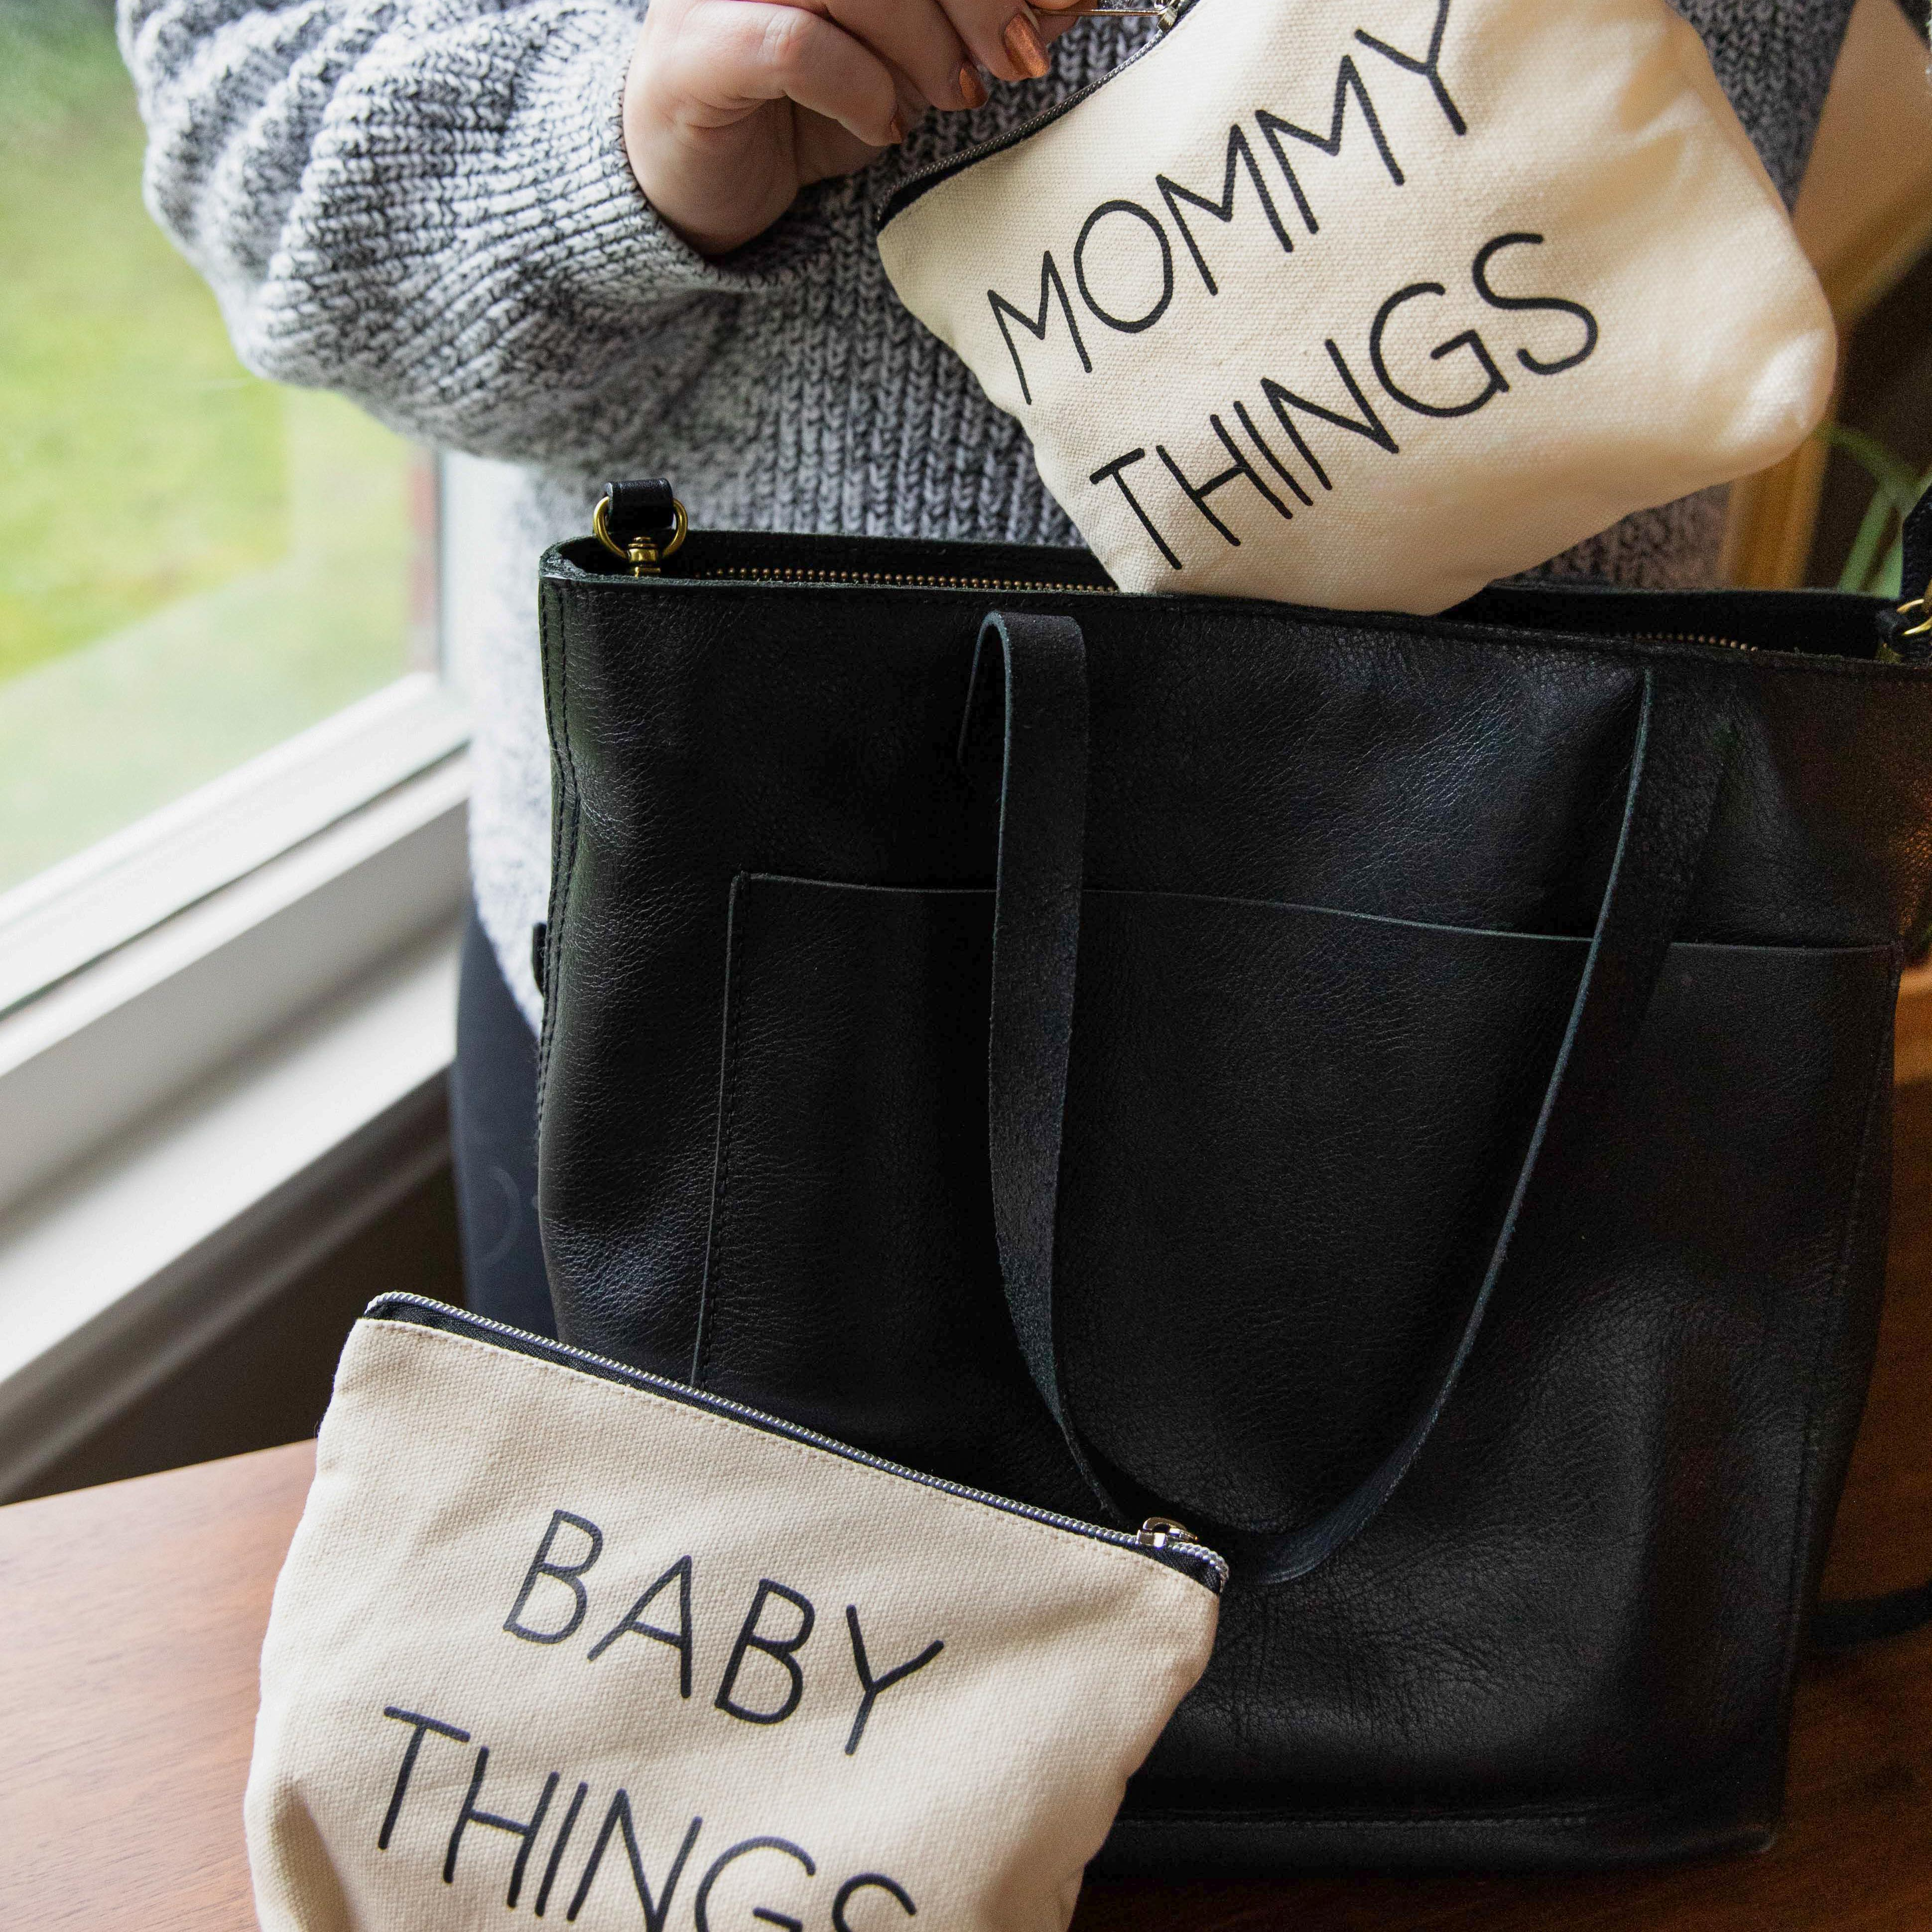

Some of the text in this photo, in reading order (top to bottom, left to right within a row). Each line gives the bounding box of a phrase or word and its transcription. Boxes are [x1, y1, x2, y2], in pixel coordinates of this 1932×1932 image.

[987, 0, 1468, 405] MOMMY
[1089, 231, 1598, 571] THINGS
[503, 1509, 945, 1756] BABY
